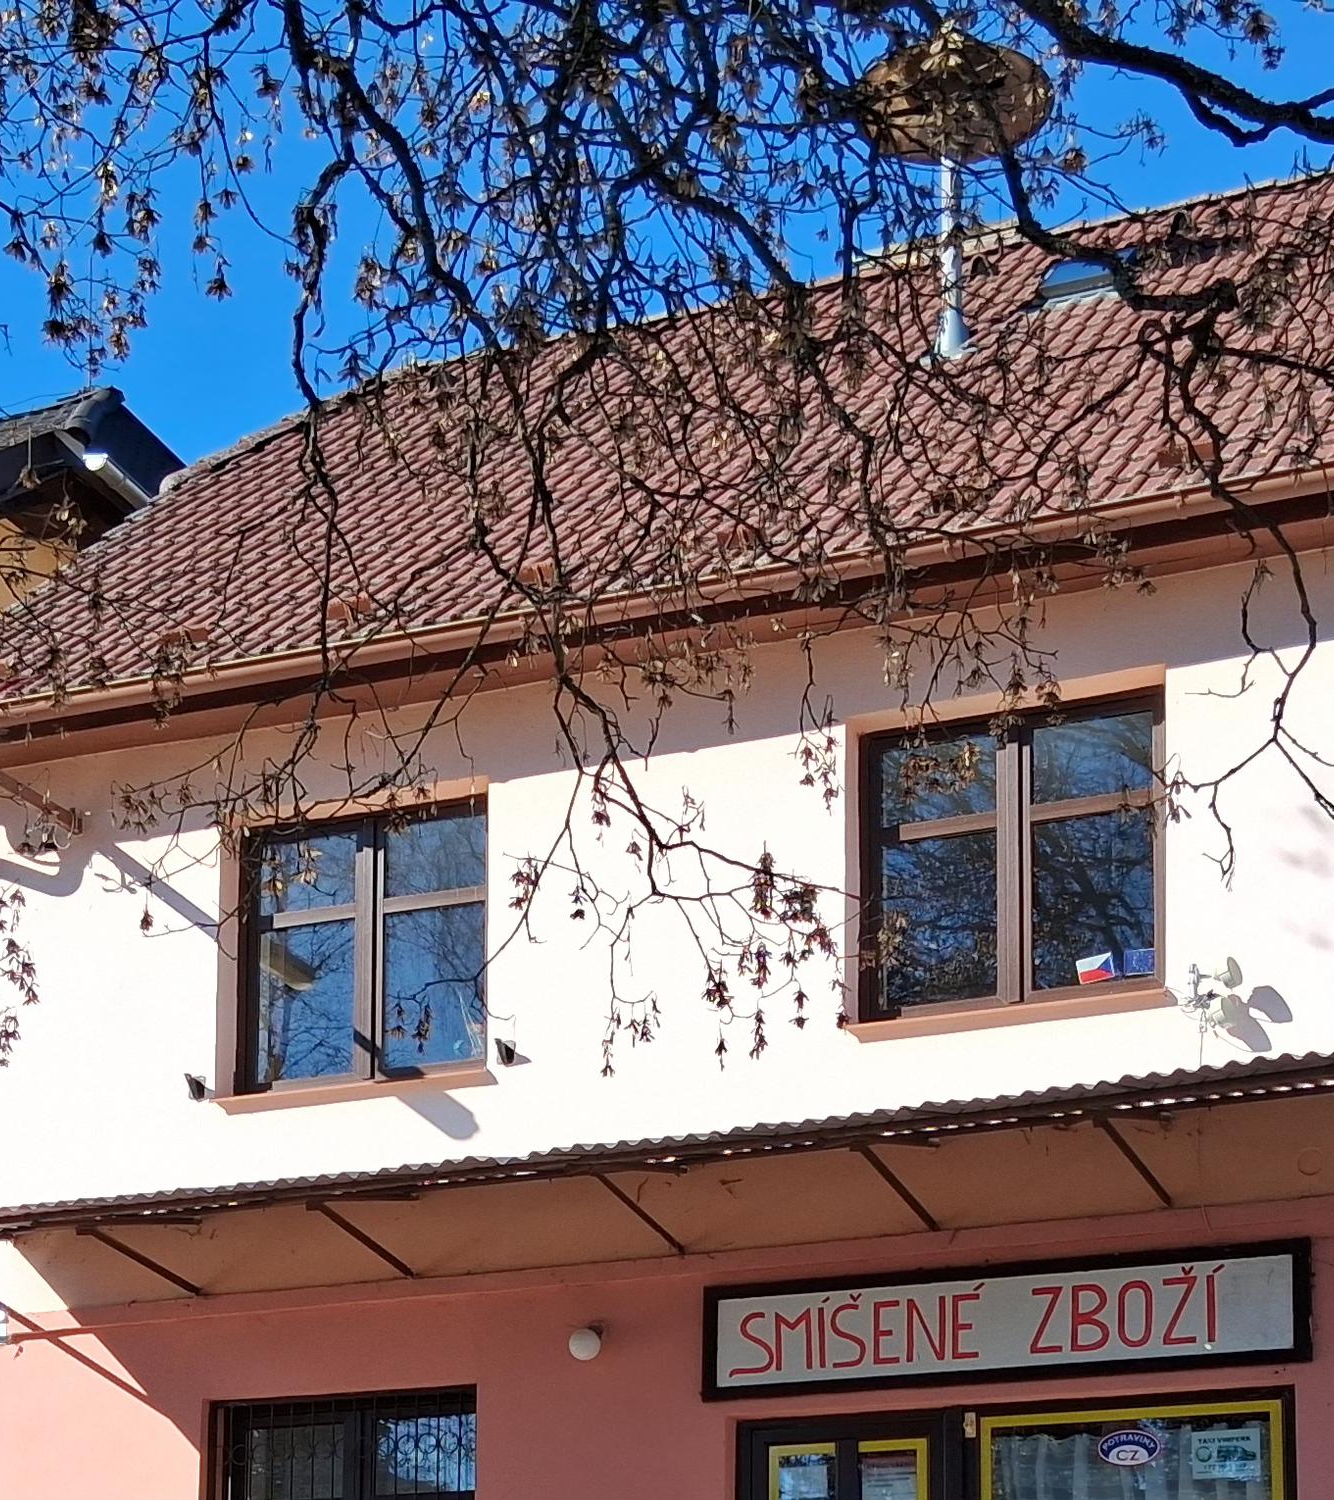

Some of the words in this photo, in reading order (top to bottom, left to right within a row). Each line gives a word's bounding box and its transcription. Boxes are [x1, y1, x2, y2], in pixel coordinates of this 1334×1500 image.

[728, 1282, 984, 1378] SMÍŠENÉ
[1029, 1263, 1226, 1354] ZBOŽÍ
[1102, 1433, 1156, 1450] POTRAVINY
[1116, 1449, 1140, 1461] CZ
